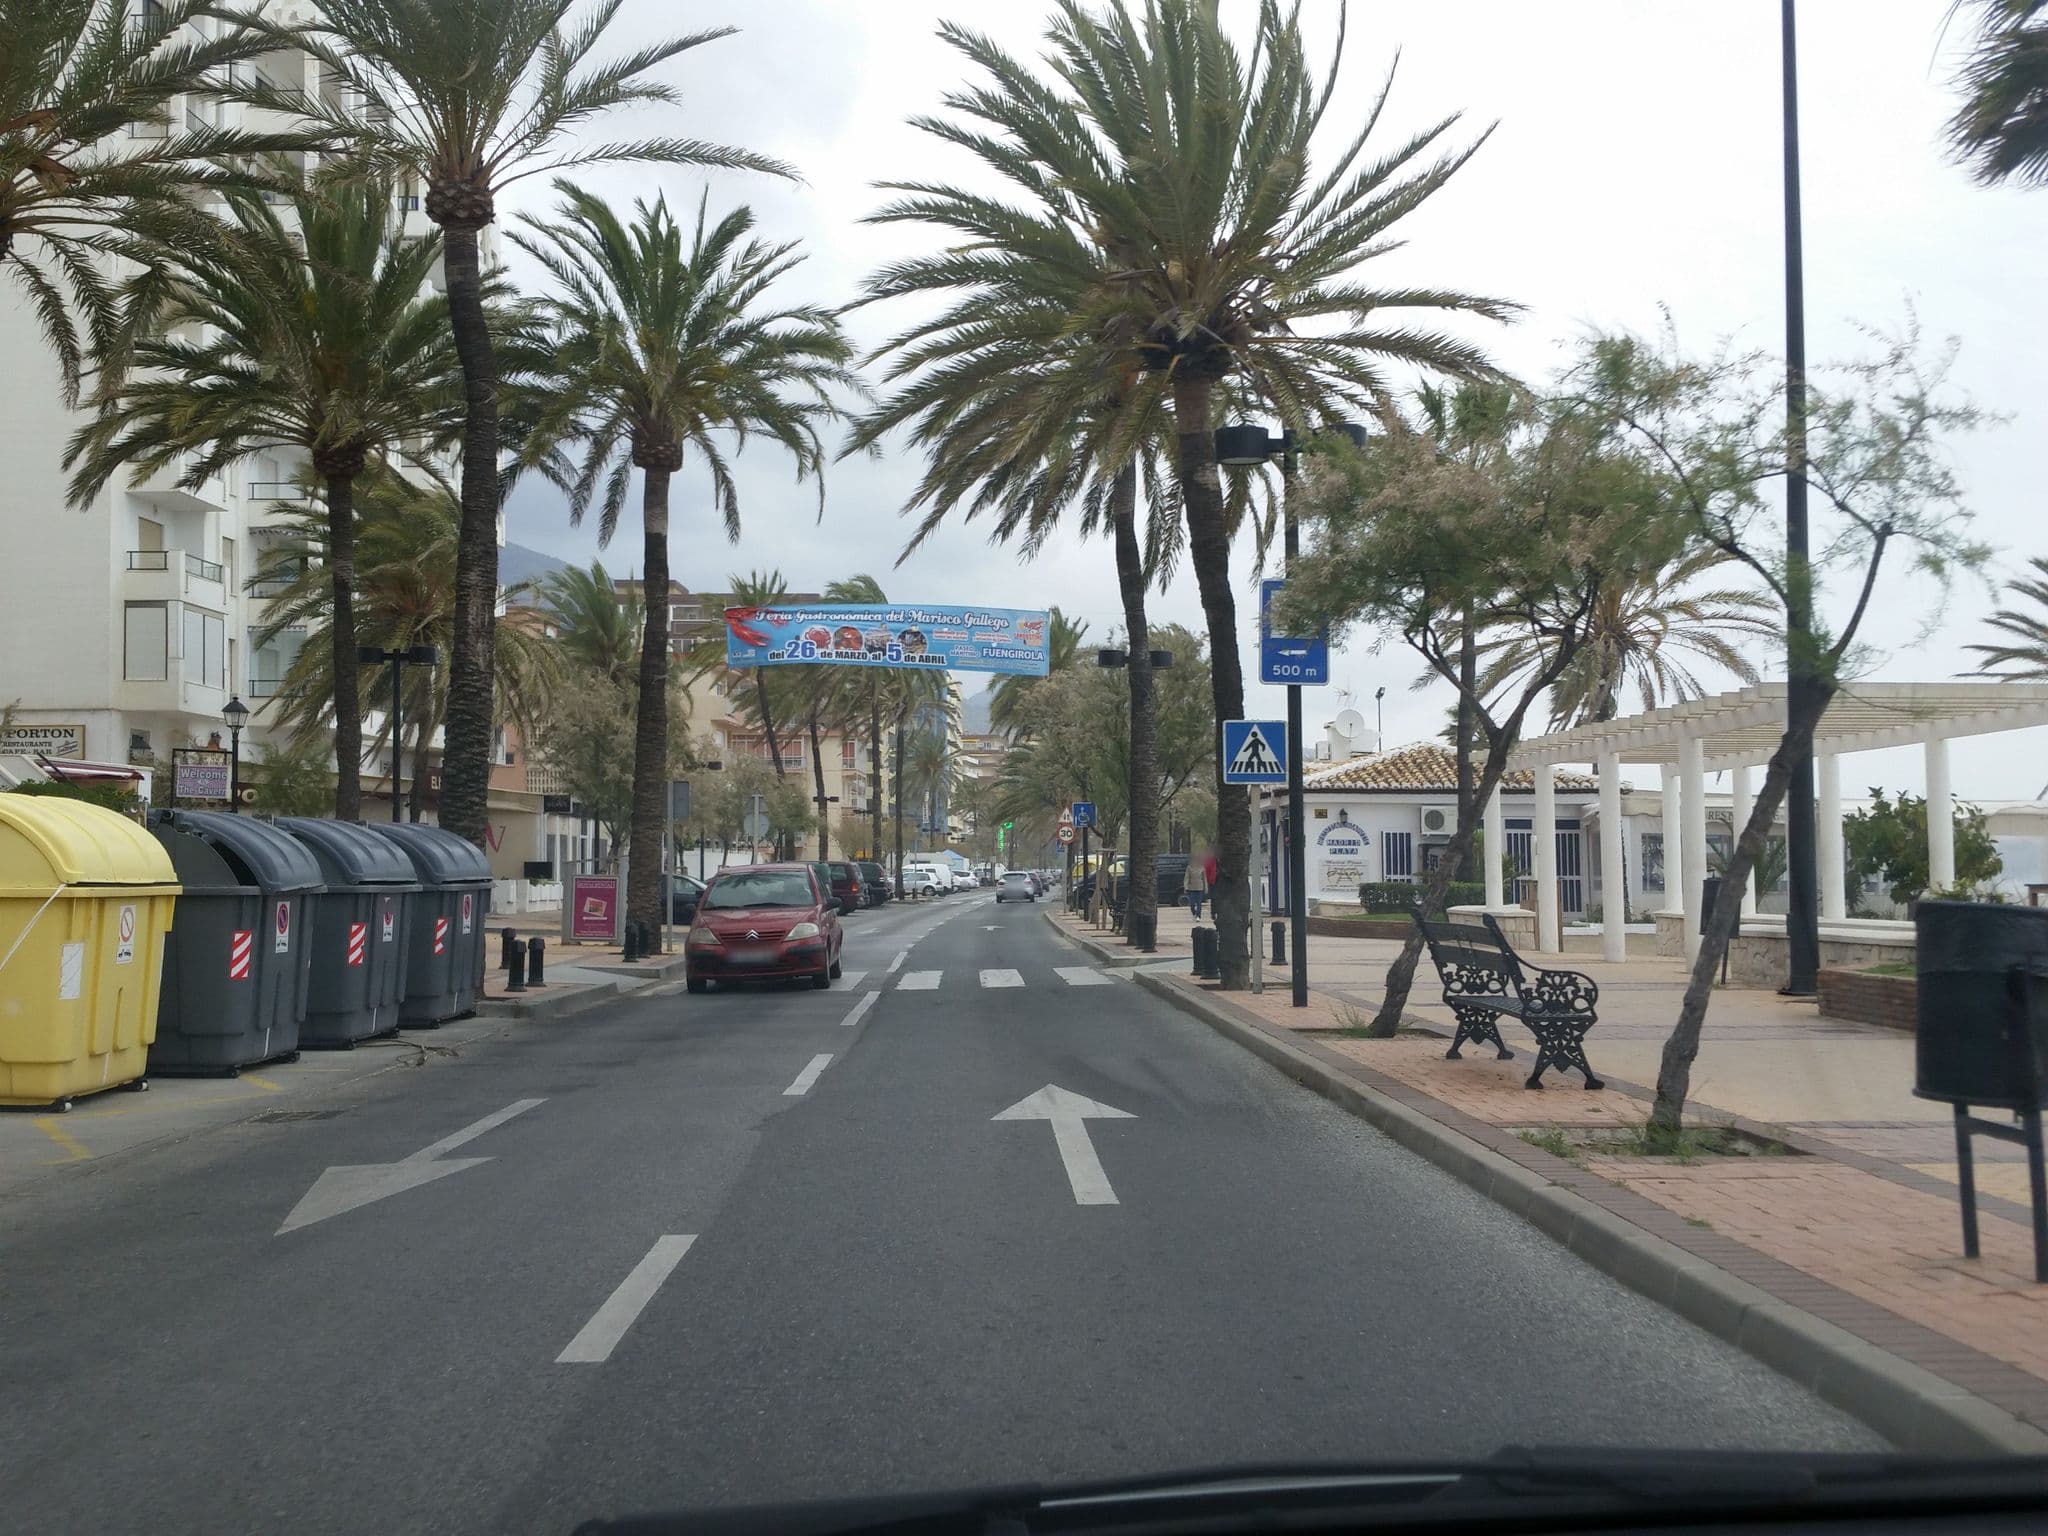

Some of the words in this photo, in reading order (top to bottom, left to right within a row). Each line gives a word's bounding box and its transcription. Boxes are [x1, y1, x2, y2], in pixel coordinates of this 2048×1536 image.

[755, 609, 793, 621] Feria
[885, 610, 904, 622] del
[907, 610, 961, 624] Marisco
[964, 612, 1009, 631] Gallego
[769, 650, 785, 660] del
[786, 640, 816, 660] 26
[820, 650, 833, 660] de
[834, 651, 868, 661] MARZO
[871, 651, 882, 661] al
[886, 643, 903, 663] 5
[904, 653, 917, 663] de
[918, 654, 947, 665] ABRIL
[982, 647, 1045, 662] FUENGIROLA
[1272, 664, 1301, 676] 500
[1305, 668, 1317, 676] m
[7, 728, 75, 738] PORTON
[181, 768, 227, 779] Welcome
[179, 785, 194, 794] The
[1060, 829, 1073, 838] 30
